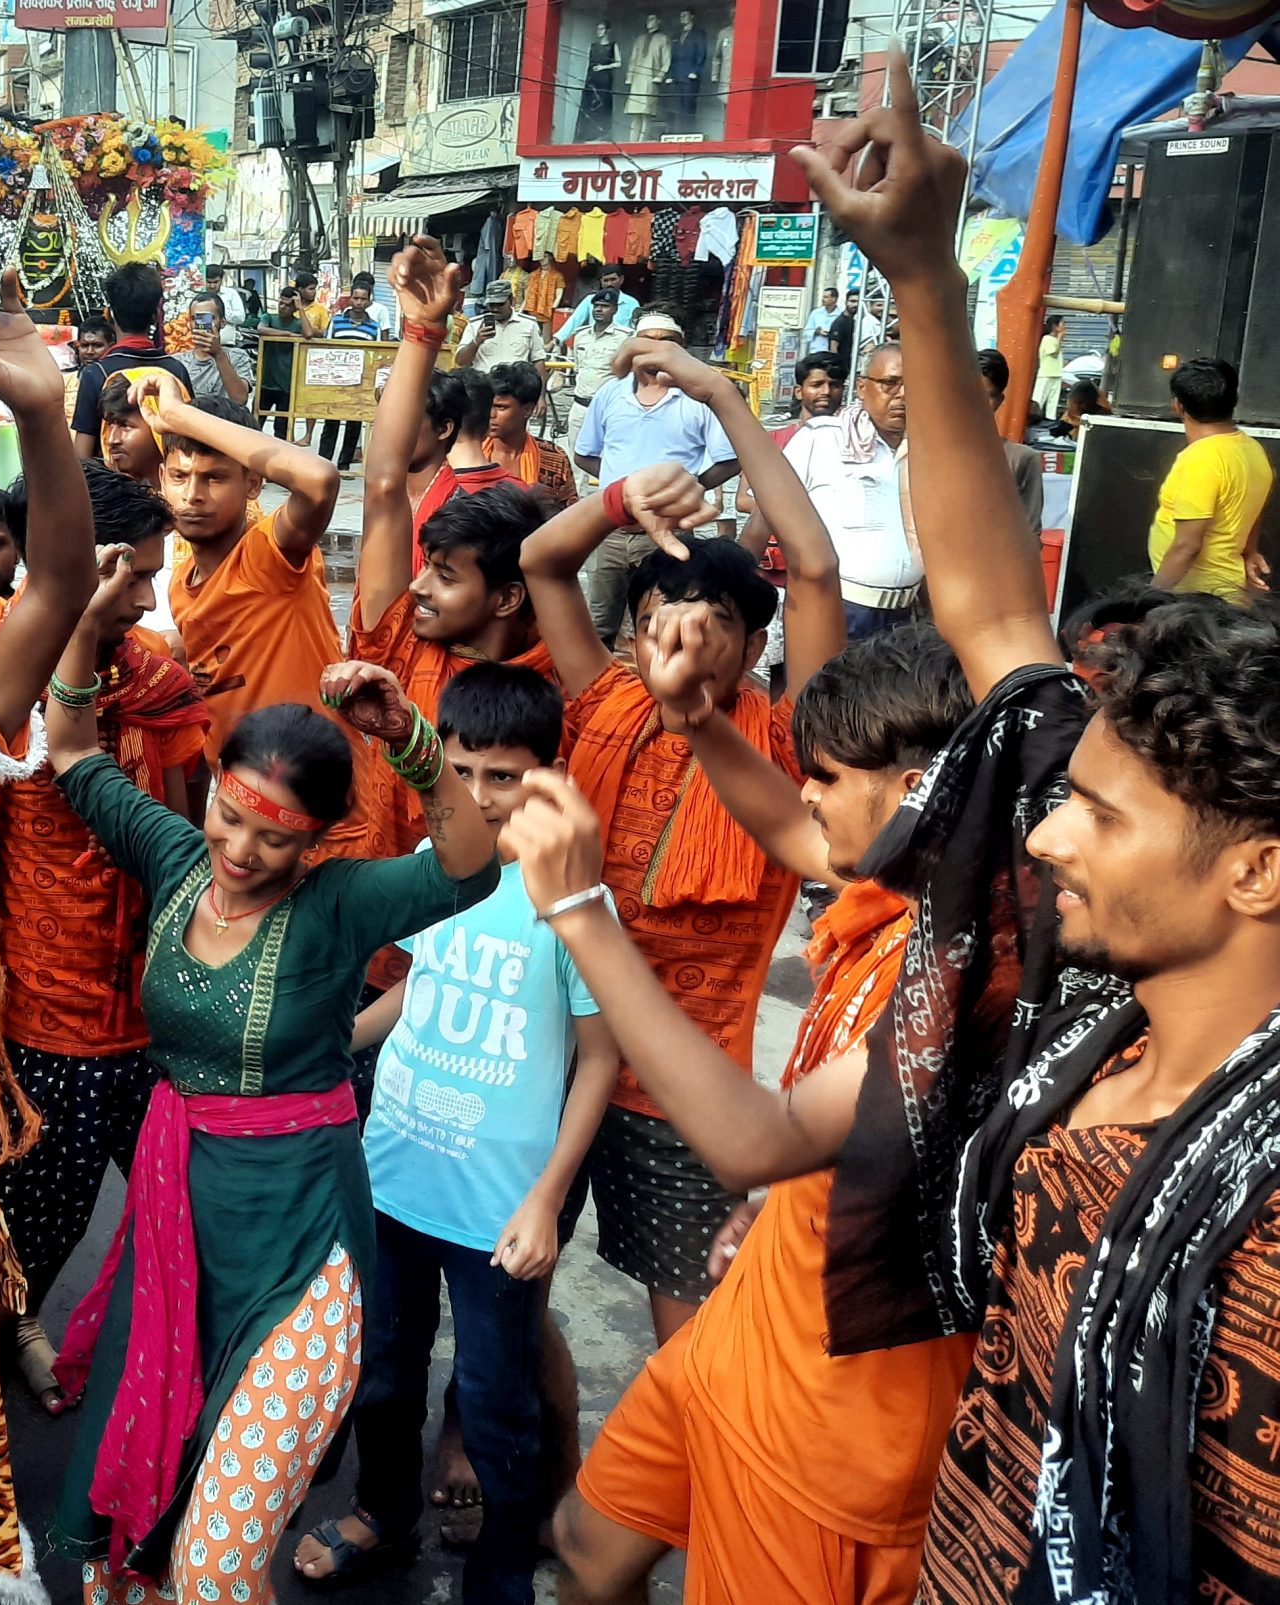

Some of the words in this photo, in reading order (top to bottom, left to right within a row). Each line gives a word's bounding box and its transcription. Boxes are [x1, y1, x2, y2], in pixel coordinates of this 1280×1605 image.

[1169, 141, 1197, 150] PRINCE
[1200, 139, 1227, 149] SOUND
[562, 156, 662, 201] गणेशा
[677, 171, 759, 199] कलेक्शन
[508, 941, 531, 958] the
[410, 974, 528, 1061] OUR
